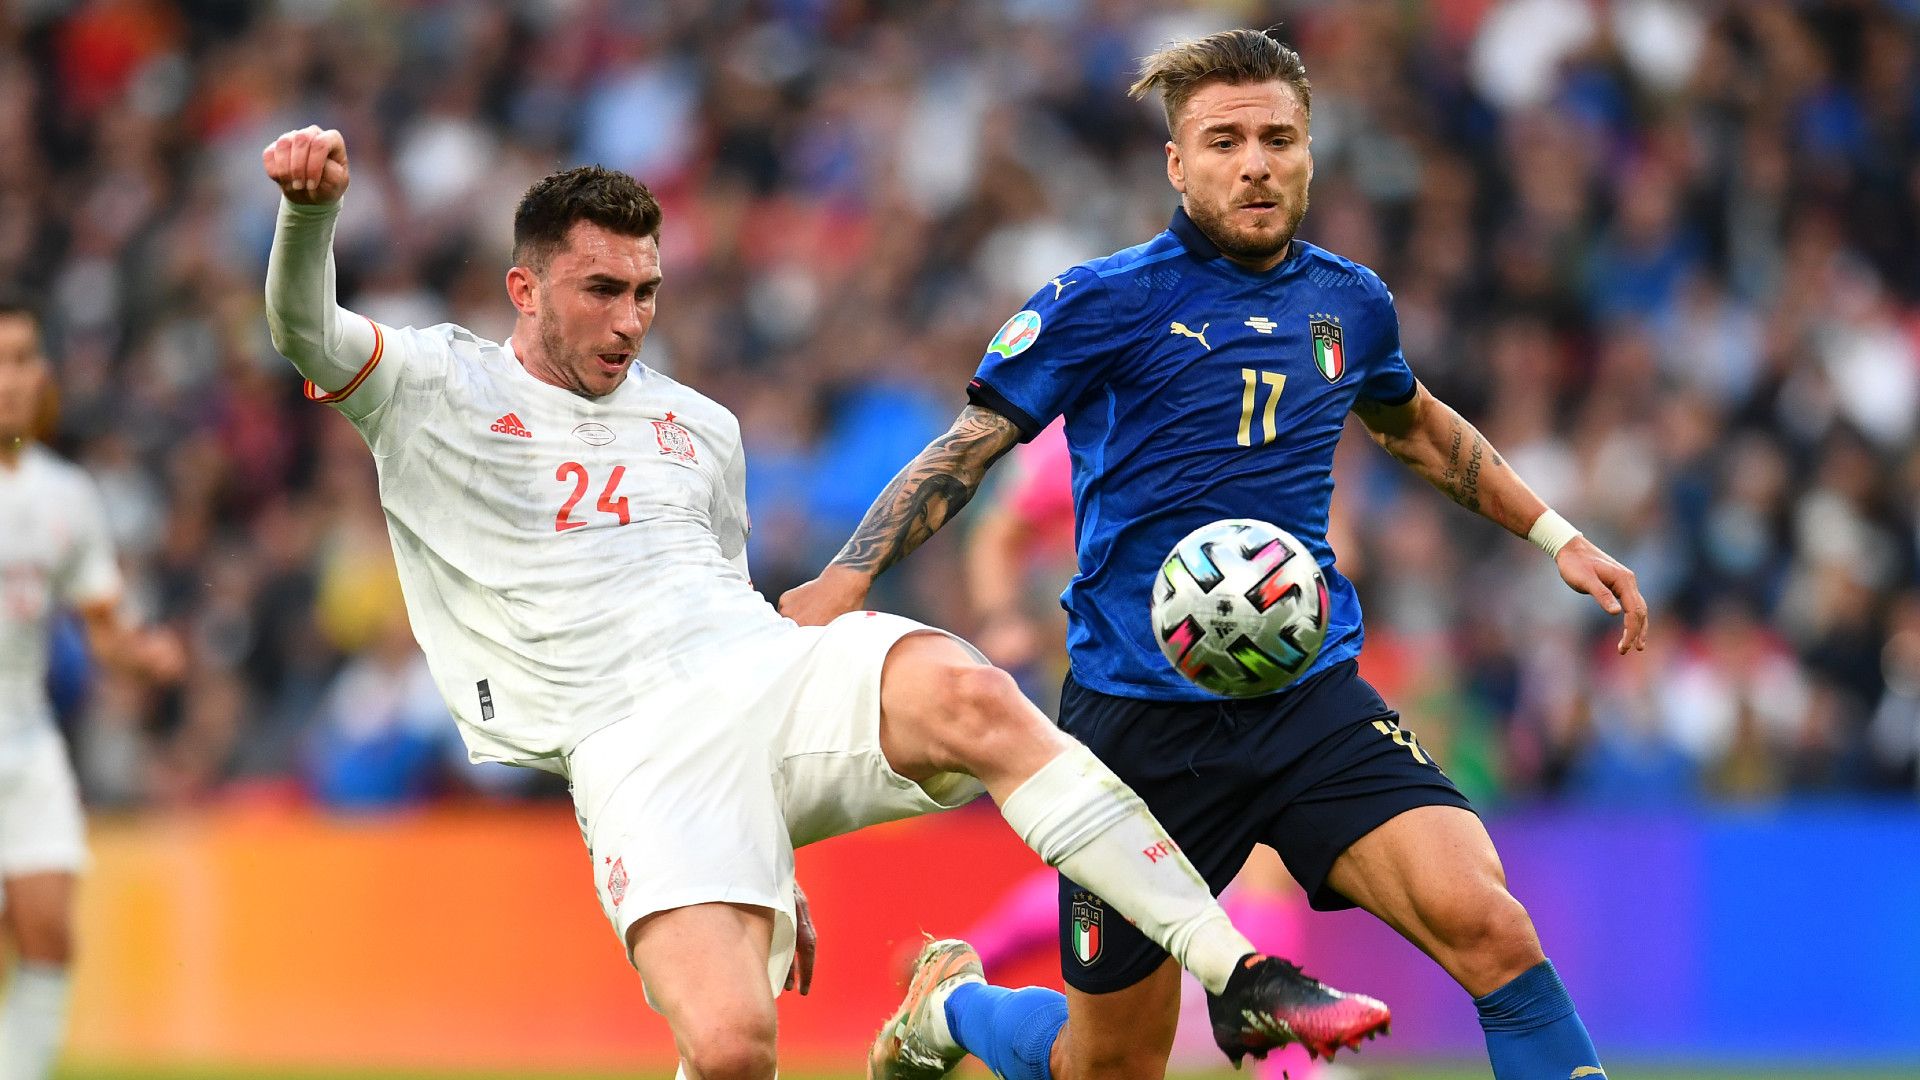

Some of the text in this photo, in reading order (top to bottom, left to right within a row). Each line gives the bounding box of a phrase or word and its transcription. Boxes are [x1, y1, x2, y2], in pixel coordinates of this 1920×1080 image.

[1313, 325, 1340, 339] ITALIA
[1236, 367, 1287, 447] 17
[490, 422, 533, 439] adidas
[555, 461, 631, 532] 24
[1074, 906, 1099, 922] ITALIA
